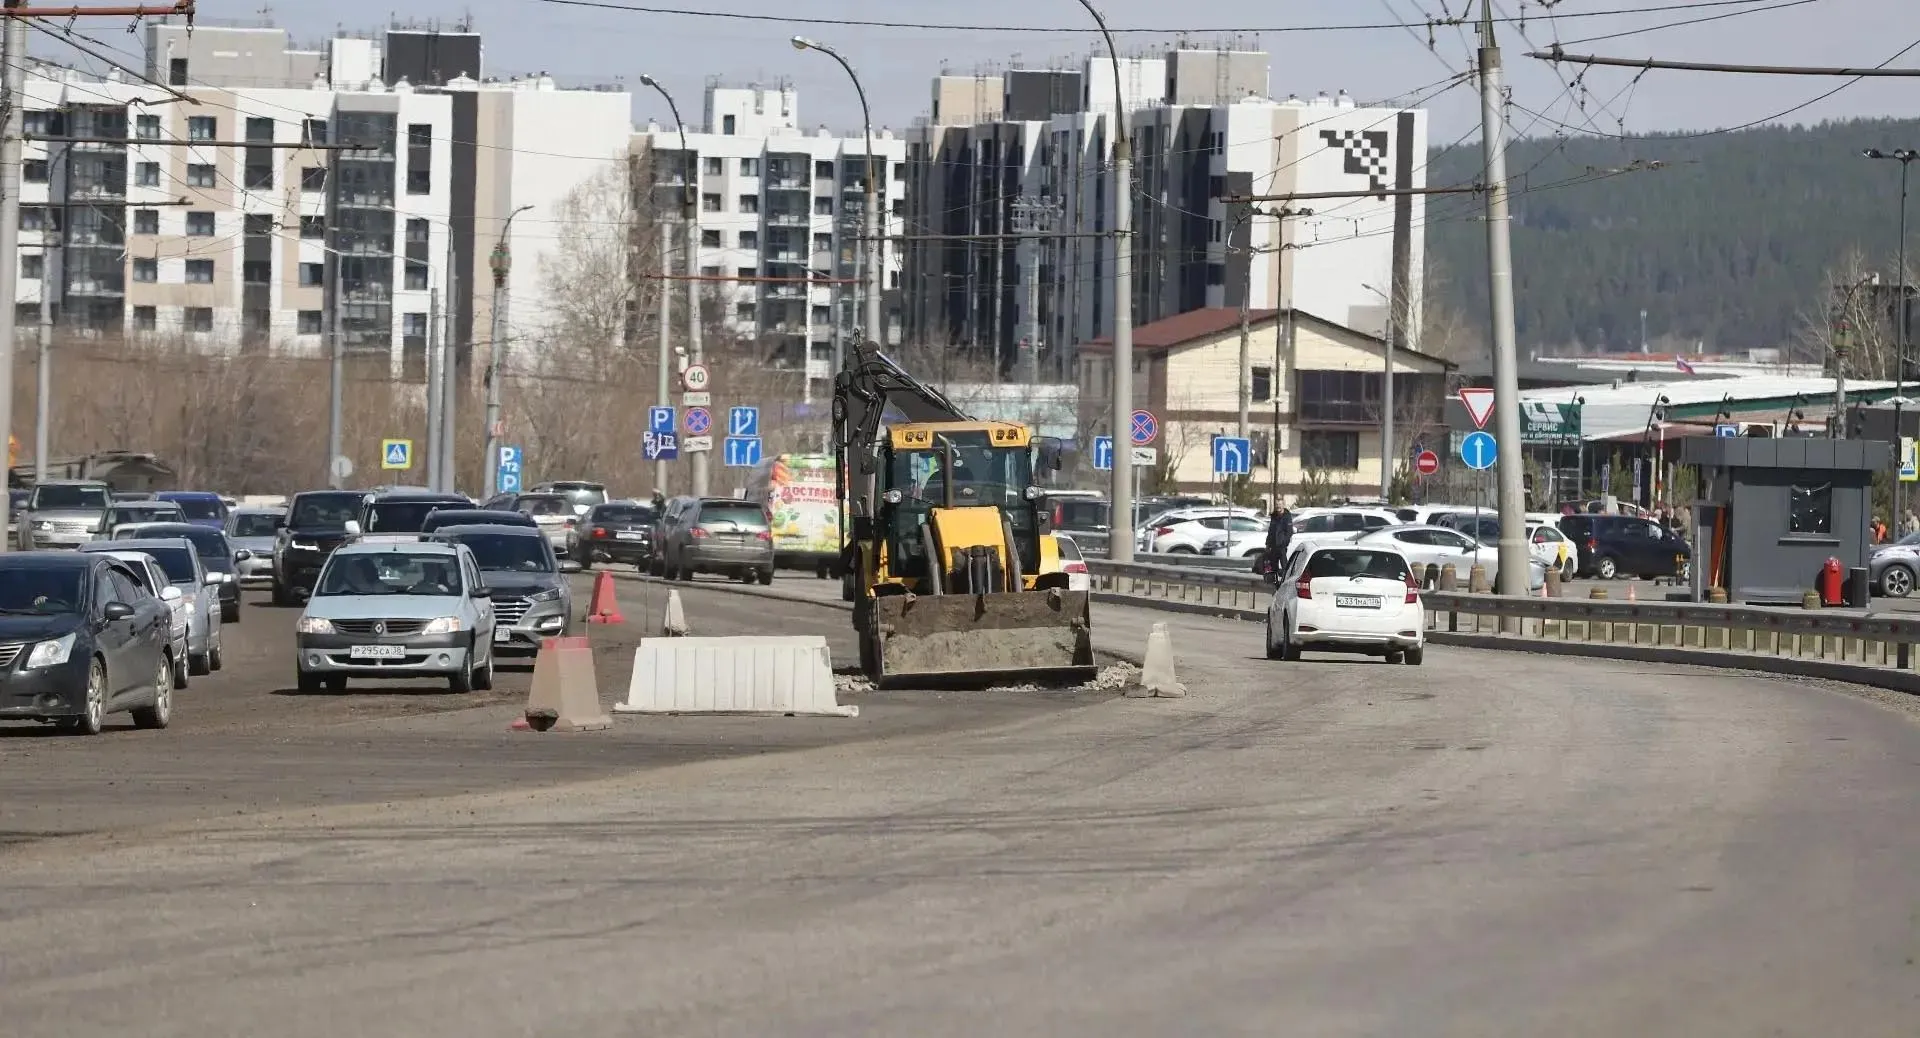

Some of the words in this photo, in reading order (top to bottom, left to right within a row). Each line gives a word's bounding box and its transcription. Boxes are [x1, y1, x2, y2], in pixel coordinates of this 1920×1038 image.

[690, 371, 705, 383] 40
[655, 410, 669, 429] P
[1527, 422, 1559, 432] СЕРВИС
